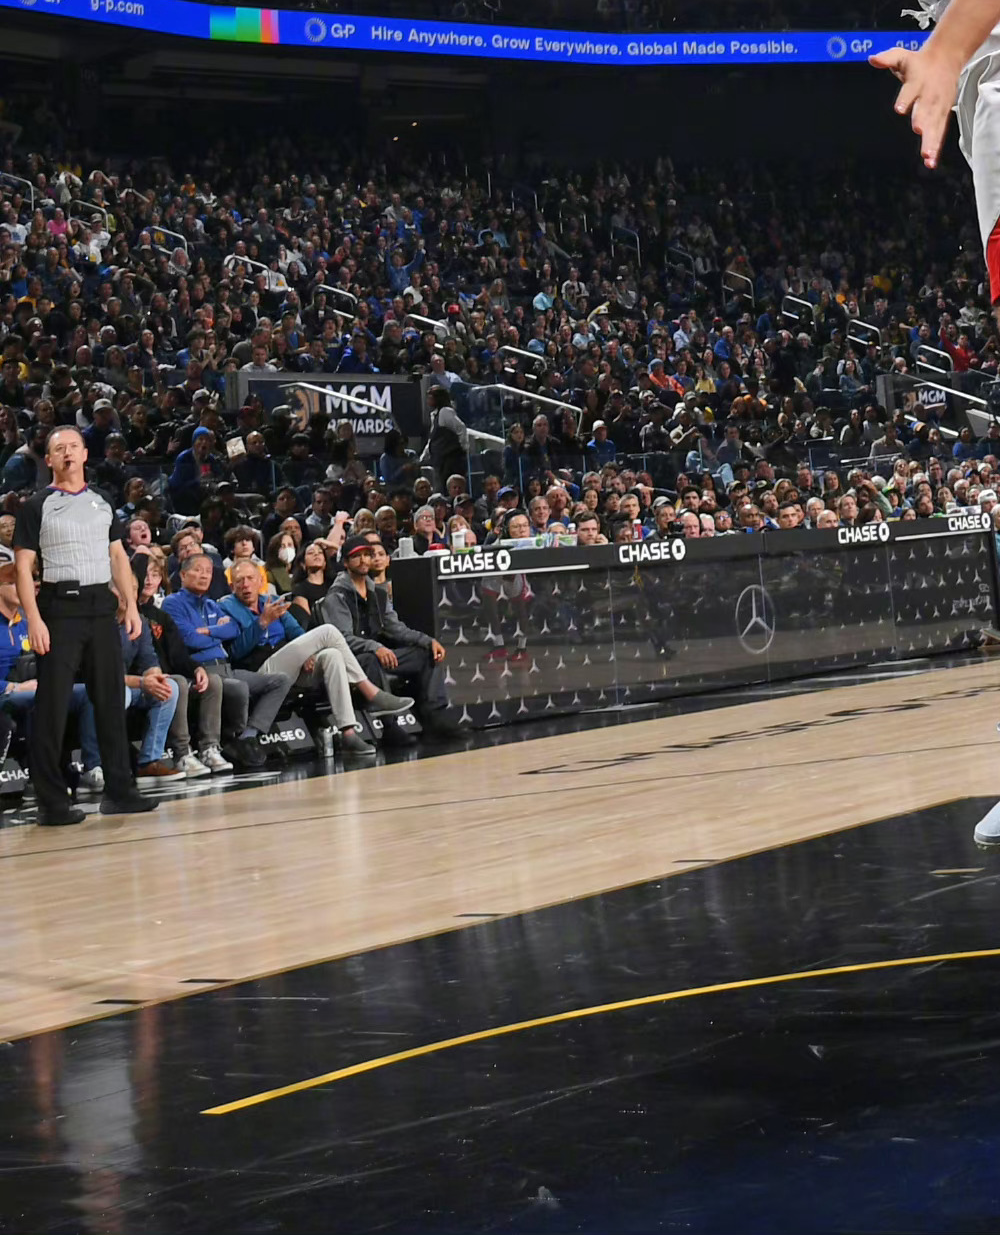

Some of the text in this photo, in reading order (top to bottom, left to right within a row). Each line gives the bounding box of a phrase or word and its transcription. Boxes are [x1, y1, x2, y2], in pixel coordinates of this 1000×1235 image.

[371, 25, 403, 41] Hire
[408, 29, 487, 48] Anywhere.
[491, 34, 530, 50] Grow
[535, 37, 622, 57] Everywhere.
[627, 41, 678, 56] Global
[683, 41, 725, 55] Made
[730, 40, 799, 55] Possible.
[325, 384, 392, 414] MGM
[919, 389, 946, 403] MGM
[948, 515, 982, 531] CHASE
[837, 525, 878, 544] CHASE
[440, 551, 494, 574] CHASE
[618, 543, 671, 563] CHASE
[259, 730, 296, 745] CHASE
[0, 767, 30, 783] CHAS
